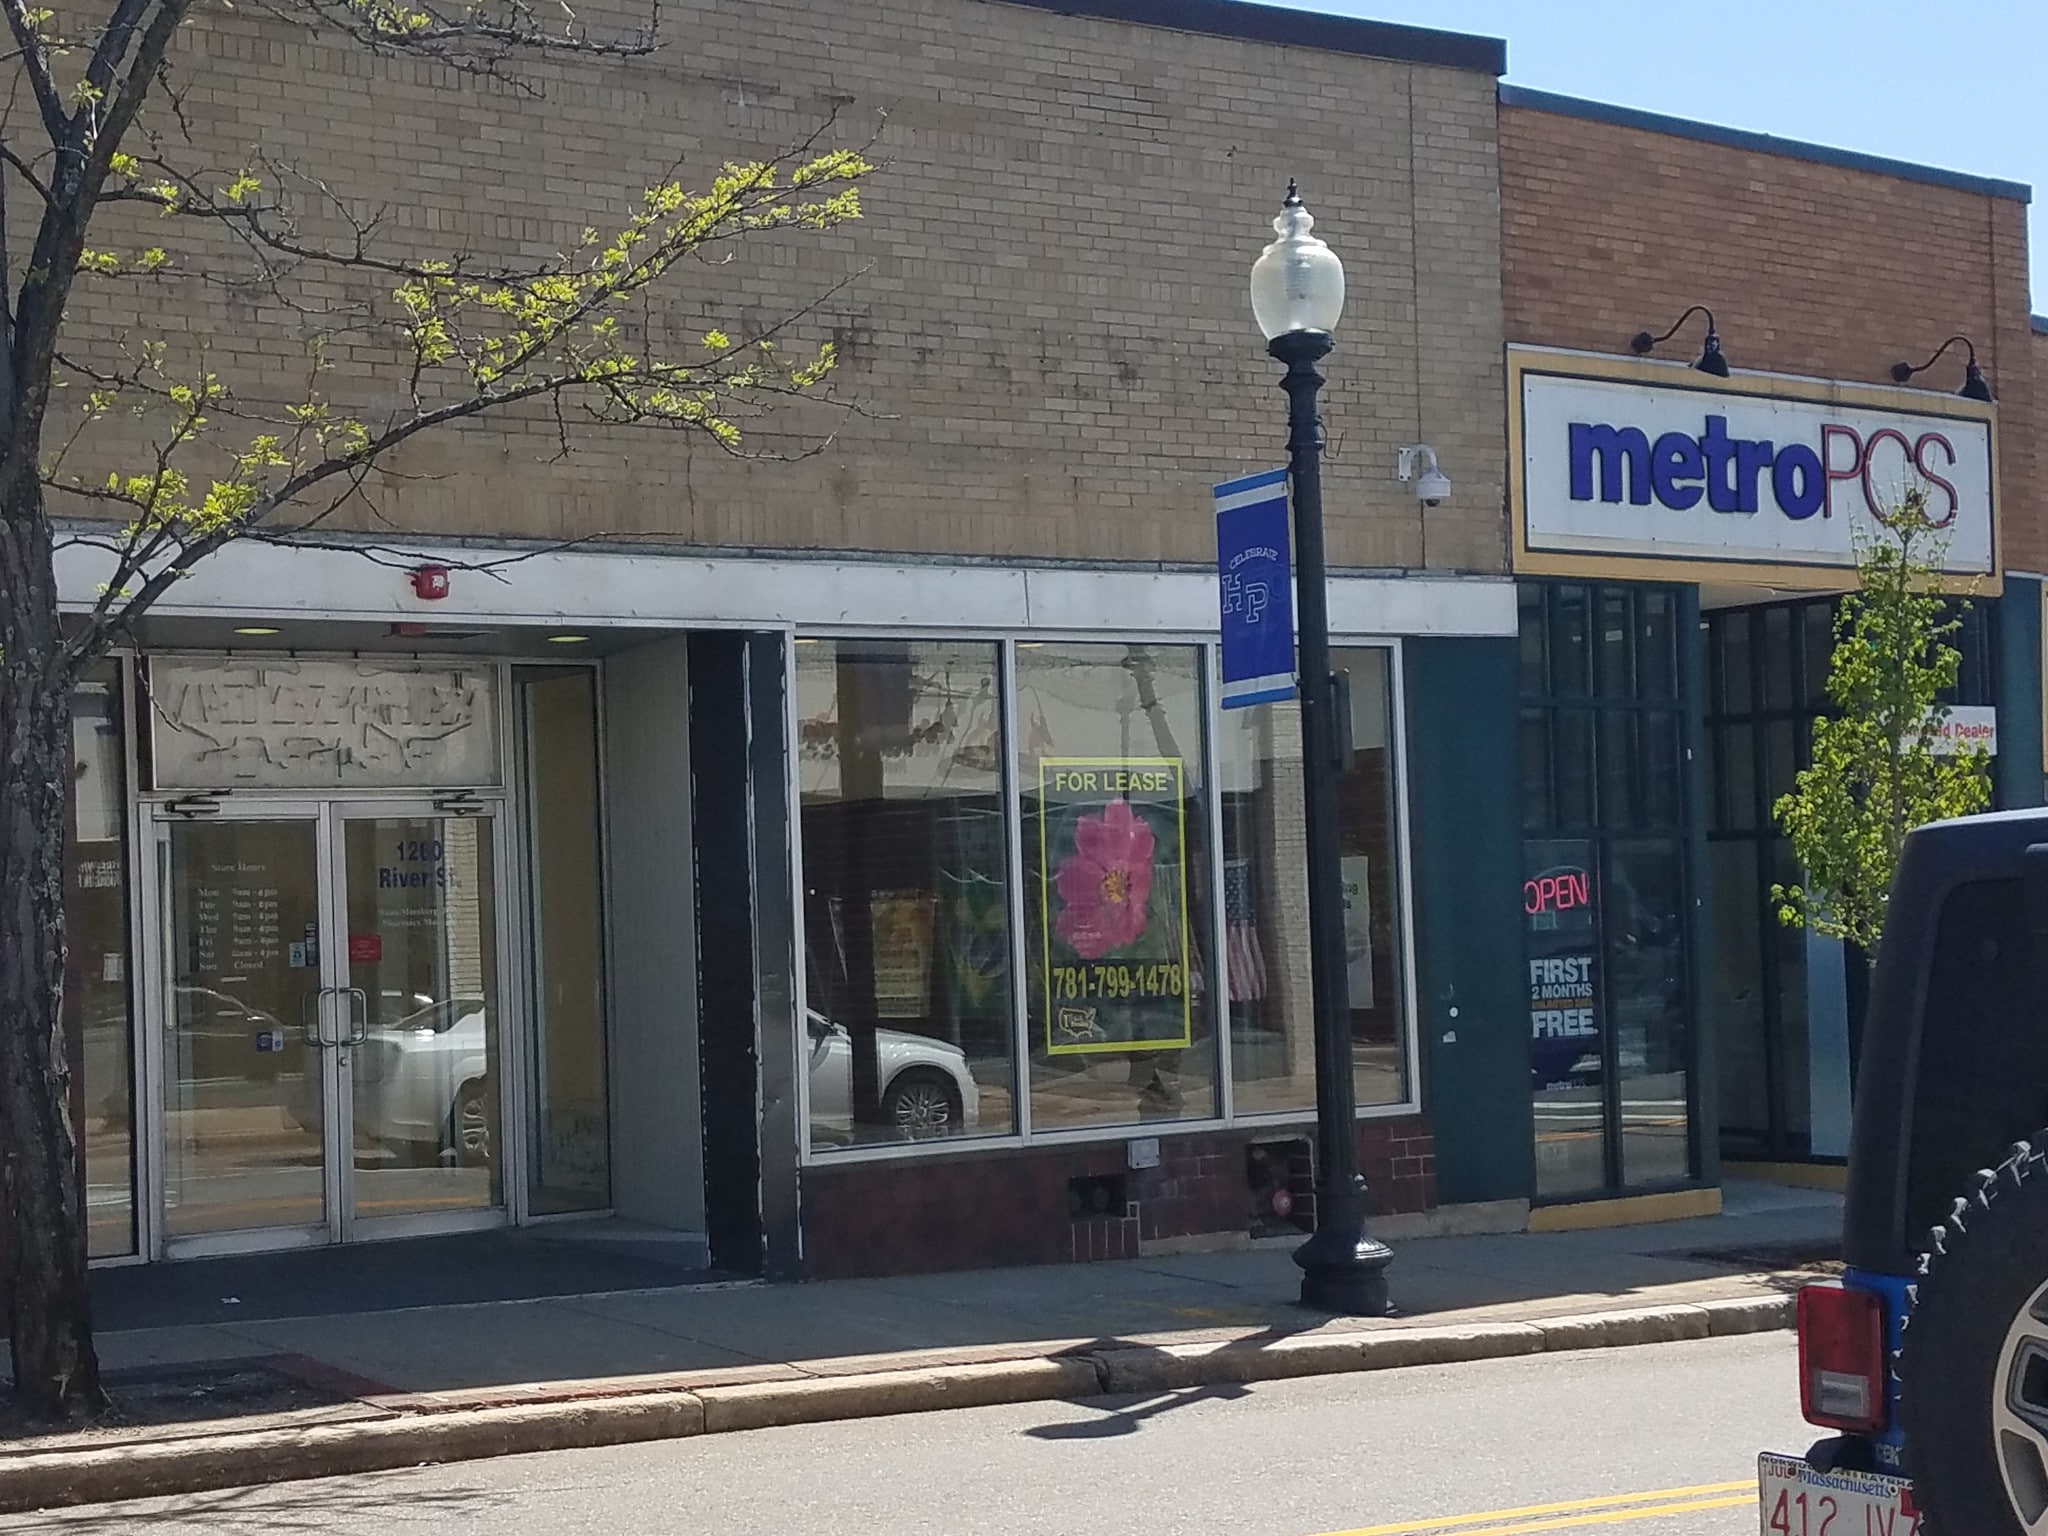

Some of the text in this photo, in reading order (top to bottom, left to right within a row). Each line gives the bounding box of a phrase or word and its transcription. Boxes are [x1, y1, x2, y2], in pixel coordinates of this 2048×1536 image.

[1569, 414, 1959, 528] metroPCS
[1229, 546, 1279, 570] CELEBRATE
[1955, 722, 1995, 739] Dealer
[1055, 772, 1168, 792] FOR LEASE
[379, 867, 429, 888] River
[1524, 872, 1589, 915] OPEN
[1053, 963, 1183, 999] 781-799-1478
[1529, 956, 1593, 985] FIRST
[1531, 982, 1593, 1000] 2 MONTHS
[1532, 1008, 1600, 1039] FREE.
[1760, 1456, 1815, 1471] NORWOO
[1768, 1464, 1791, 1479] JUL
[1798, 1469, 1892, 1498] Massachusetts
[1770, 1488, 1838, 1536] 412
